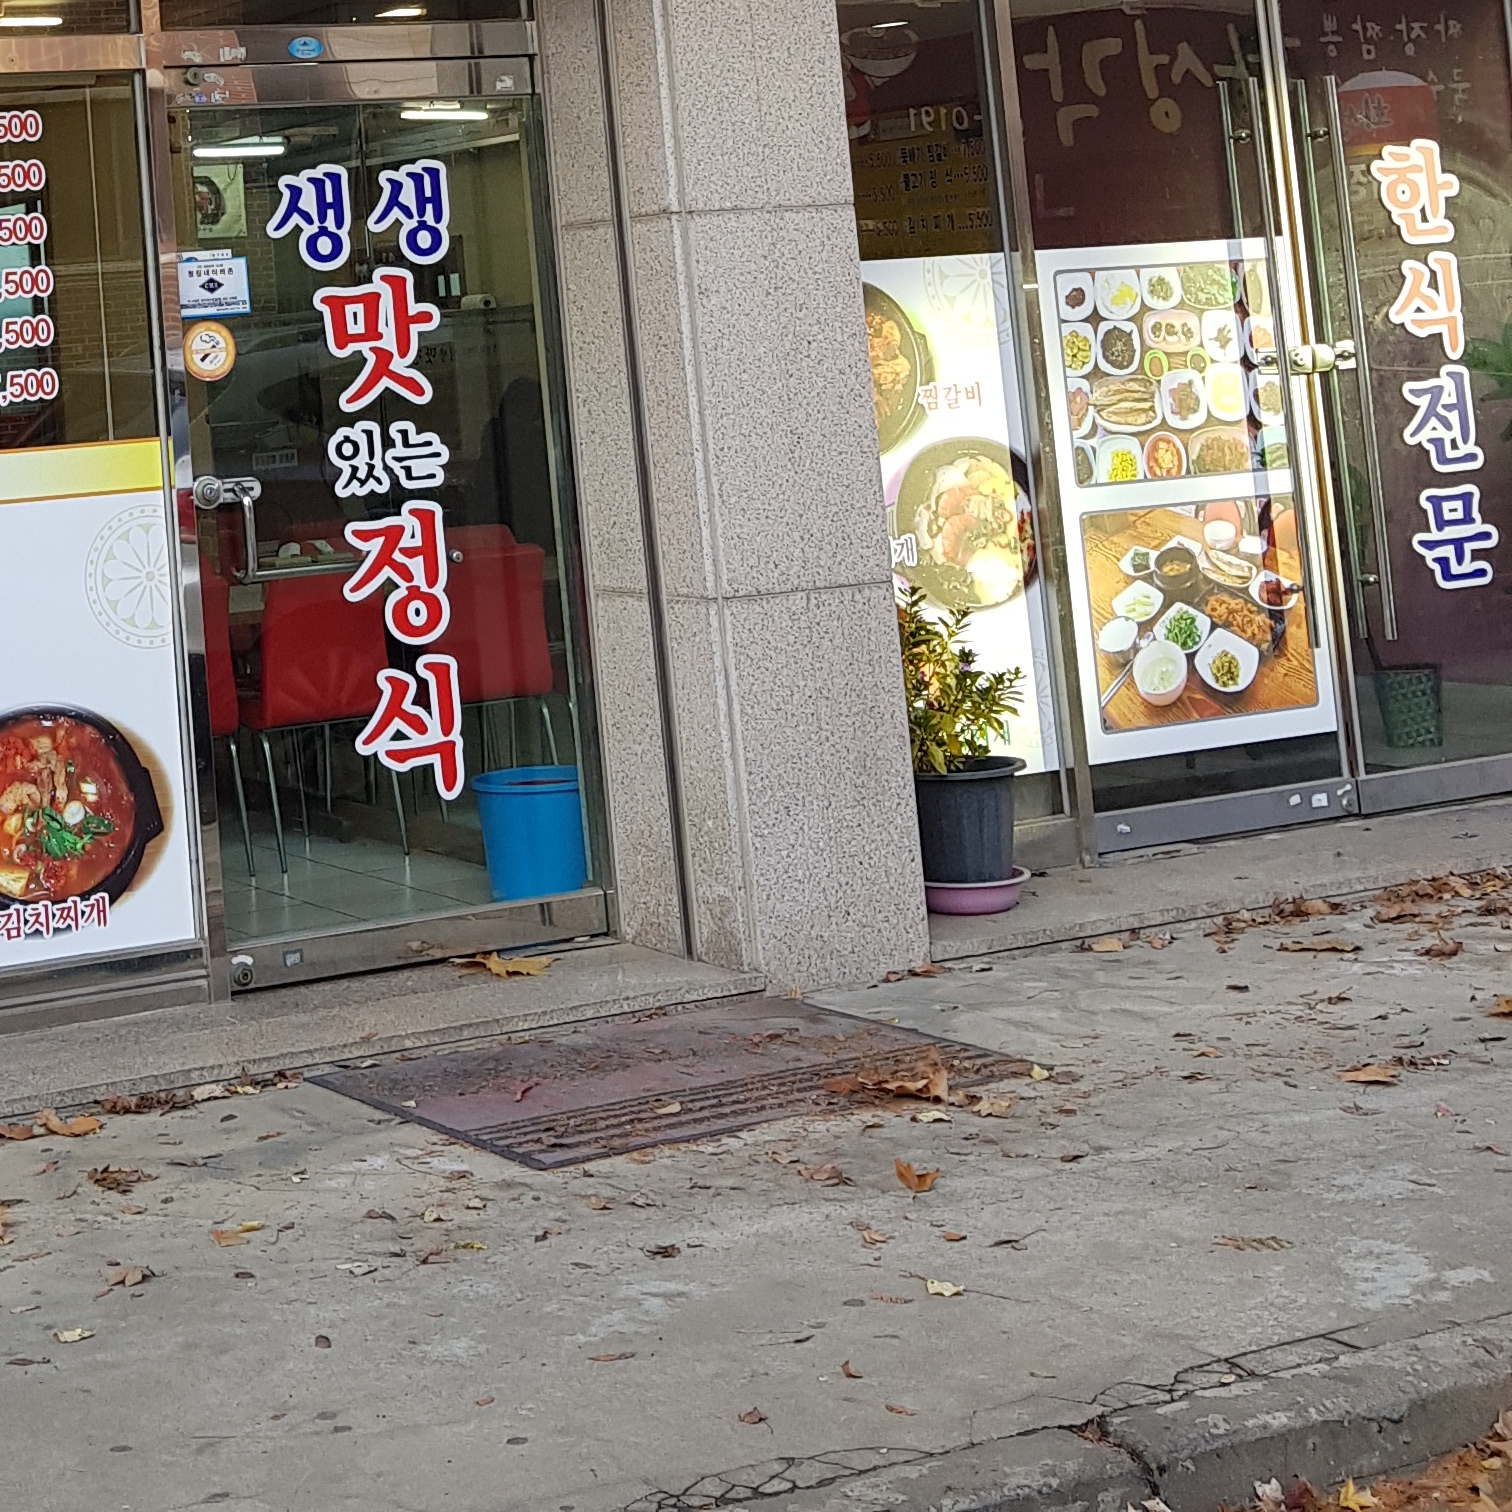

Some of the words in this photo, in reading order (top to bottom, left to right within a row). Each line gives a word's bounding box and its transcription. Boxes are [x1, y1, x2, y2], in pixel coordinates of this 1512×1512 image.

[266, 159, 449, 270] 생생
[918, 383, 983, 412] 찜갈비
[1370, 138, 1500, 589] 한식전문
